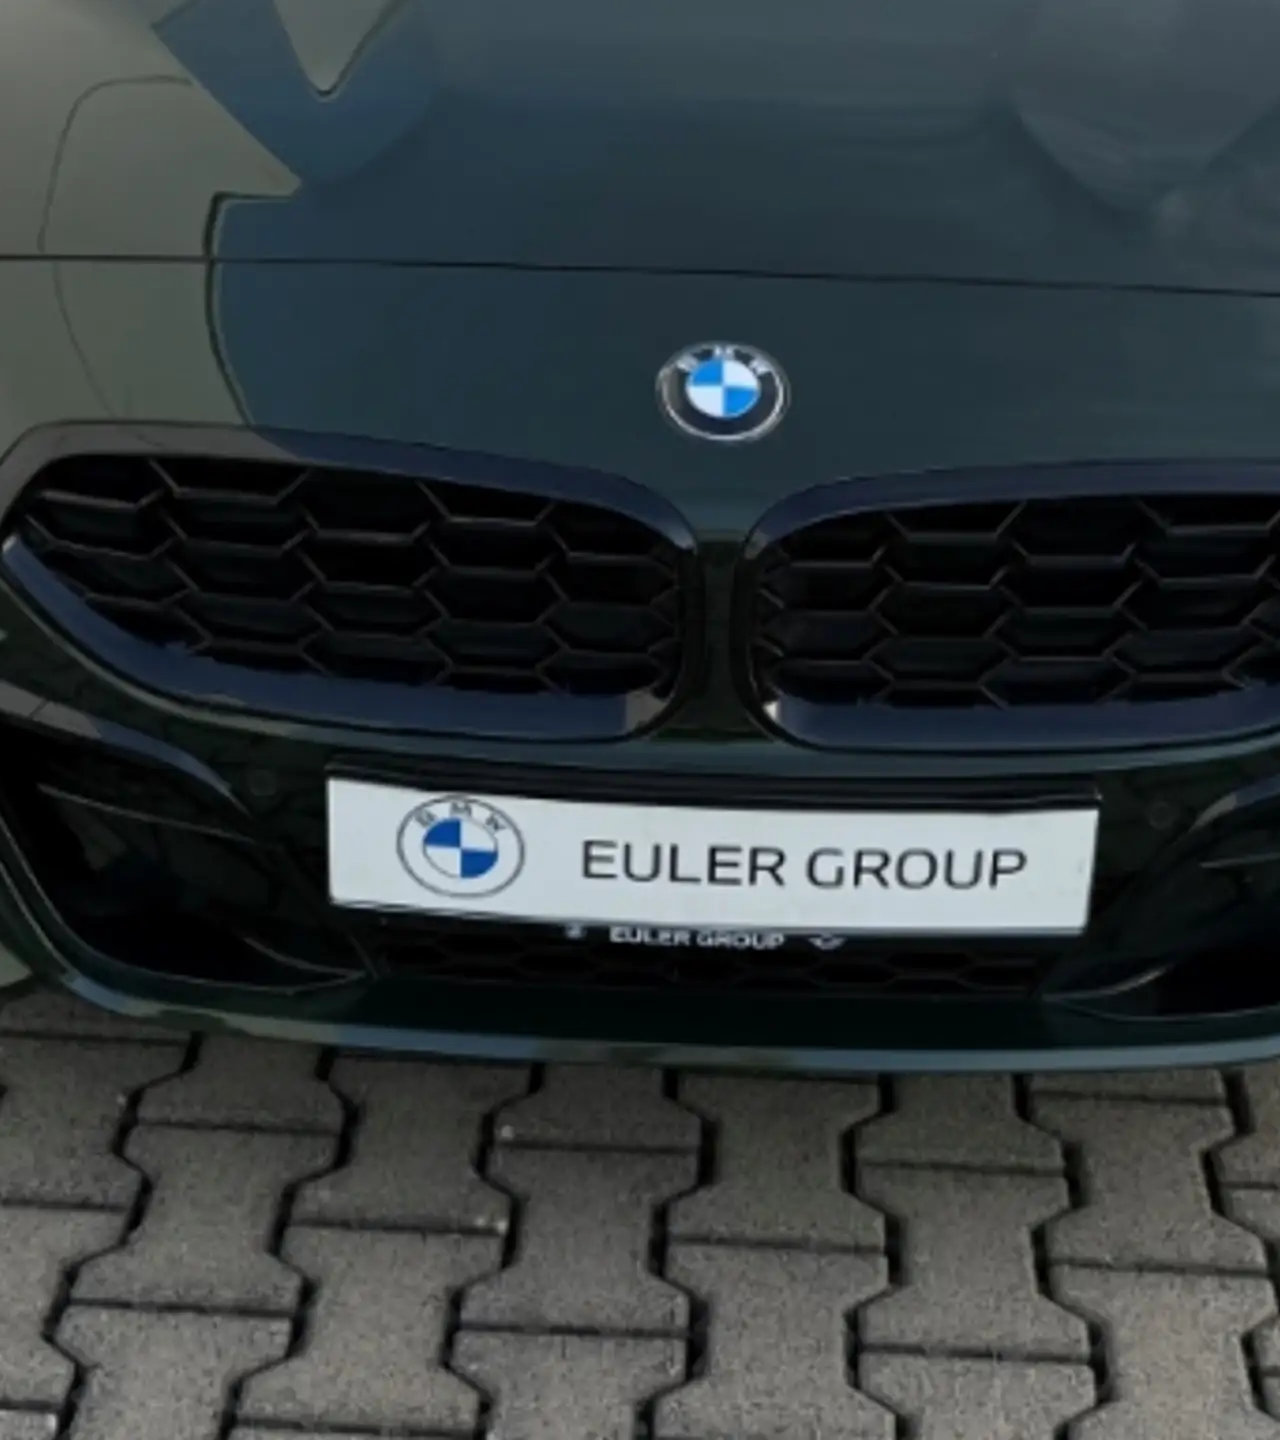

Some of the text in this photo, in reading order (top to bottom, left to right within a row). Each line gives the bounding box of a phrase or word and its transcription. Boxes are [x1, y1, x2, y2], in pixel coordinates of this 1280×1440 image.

[581, 839, 1029, 891] EULER GROUP
[608, 926, 785, 951] EULER GROUP
